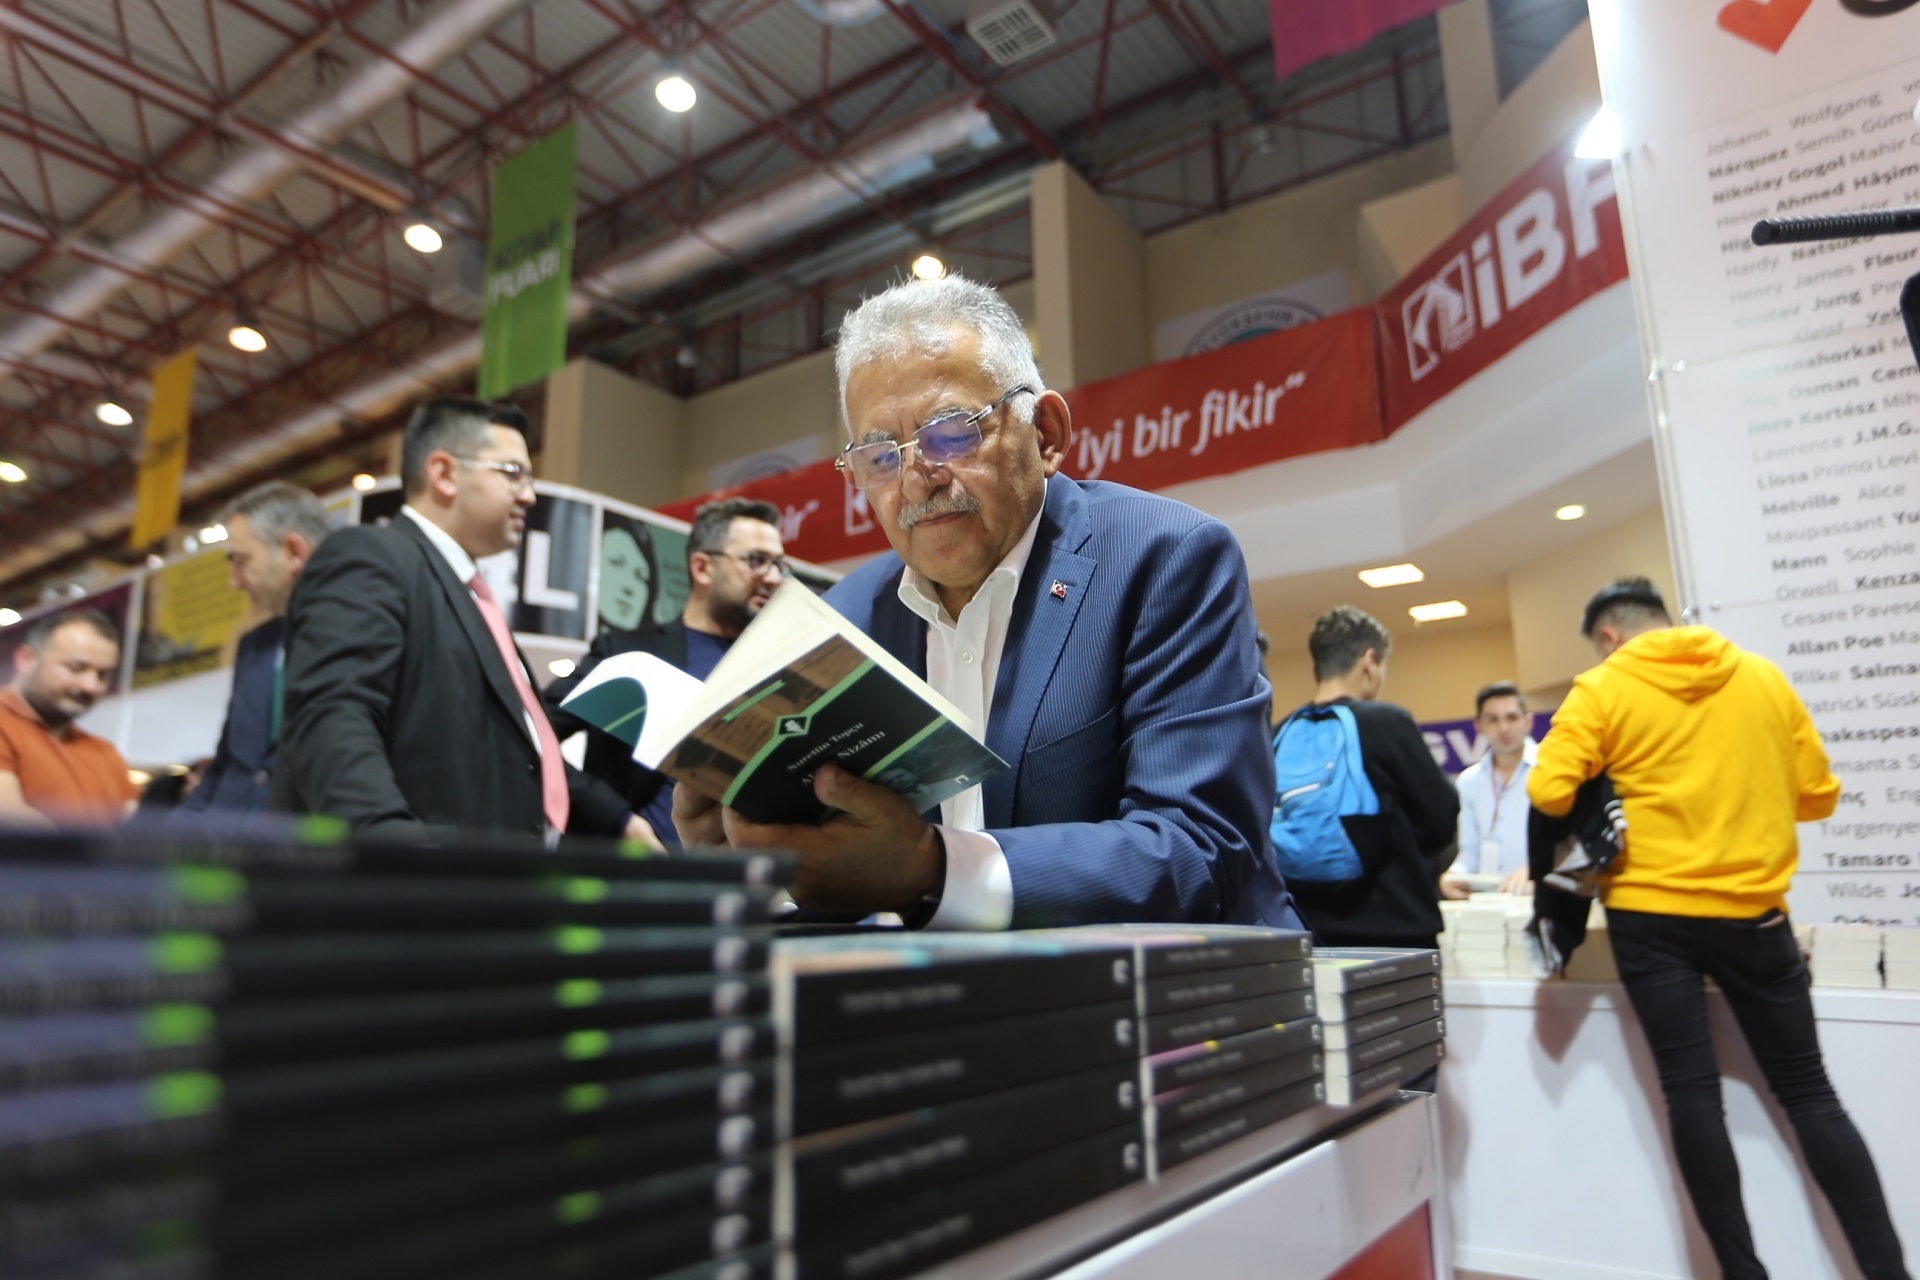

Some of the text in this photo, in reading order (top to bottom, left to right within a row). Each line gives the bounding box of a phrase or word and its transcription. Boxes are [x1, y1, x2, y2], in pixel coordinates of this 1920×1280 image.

[1790, 92, 1882, 129] Wolfgang
[1795, 126, 1855, 155] Semih
[1712, 175, 1784, 205] Nikolay
[1787, 154, 1847, 183] Gogol
[1850, 136, 1907, 165] Mahir
[1775, 182, 1847, 213] Ahmed
[1863, 246, 1920, 271] Fleur
[1811, 290, 1863, 313] Jung
[1788, 374, 1860, 401] Osman
[1131, 405, 1191, 458] bir
[1812, 460, 1874, 481] Primo
[1761, 484, 1907, 517] Melville Alice
[1765, 516, 1887, 545] Maupassant
[1771, 540, 1916, 573] Mann Sophie
[1775, 578, 1840, 601] Orwell
[1780, 608, 1848, 628] Cesare
[1786, 640, 1840, 657] Allan
[1843, 635, 1885, 651] Poe
[1806, 695, 1868, 715] atrick
[1822, 851, 1911, 868] Tamaro
[1824, 880, 1887, 899] Wilde
